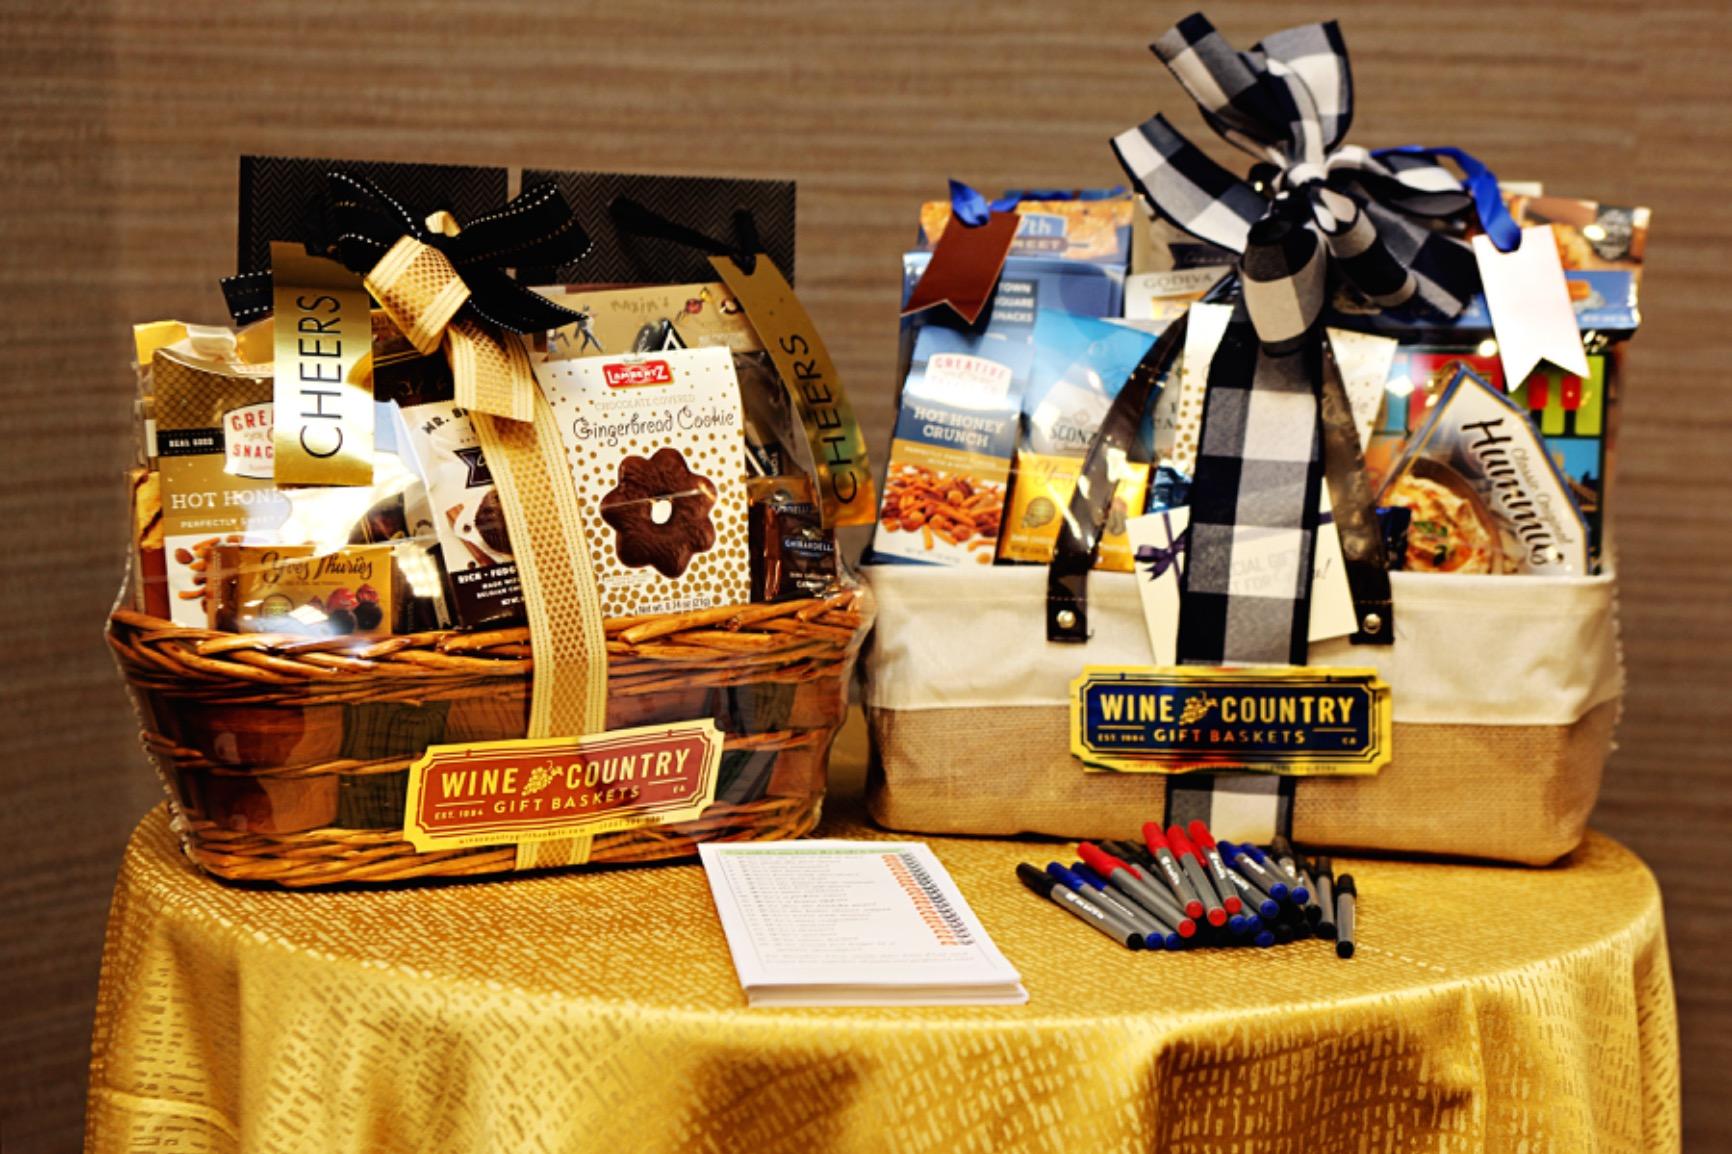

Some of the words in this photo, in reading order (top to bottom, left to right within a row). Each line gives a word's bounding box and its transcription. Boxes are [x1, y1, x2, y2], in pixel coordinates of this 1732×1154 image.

[1143, 272, 1213, 289] GODIVA
[296, 295, 343, 459] CHEERS
[231, 408, 275, 432] CRE
[573, 410, 673, 447] Gingerbread
[677, 405, 734, 431] Cookie
[779, 334, 858, 504] CHEERS
[914, 406, 946, 424] HOT
[949, 413, 1005, 434] HONEY
[923, 423, 990, 448] CRUNCH
[232, 443, 274, 460] SNAC
[171, 491, 217, 510] HOT
[223, 487, 279, 506] HONE
[1462, 418, 1564, 565] Hummus
[1099, 693, 1176, 722] WINE
[1221, 695, 1356, 724] COUNTRY
[1153, 728, 1201, 743] GIFT
[1209, 729, 1306, 744] BASKETS
[441, 767, 519, 798] WINE
[565, 748, 691, 789] COUNTRY
[493, 798, 542, 814] GIFT
[552, 785, 640, 811] BASKETS
